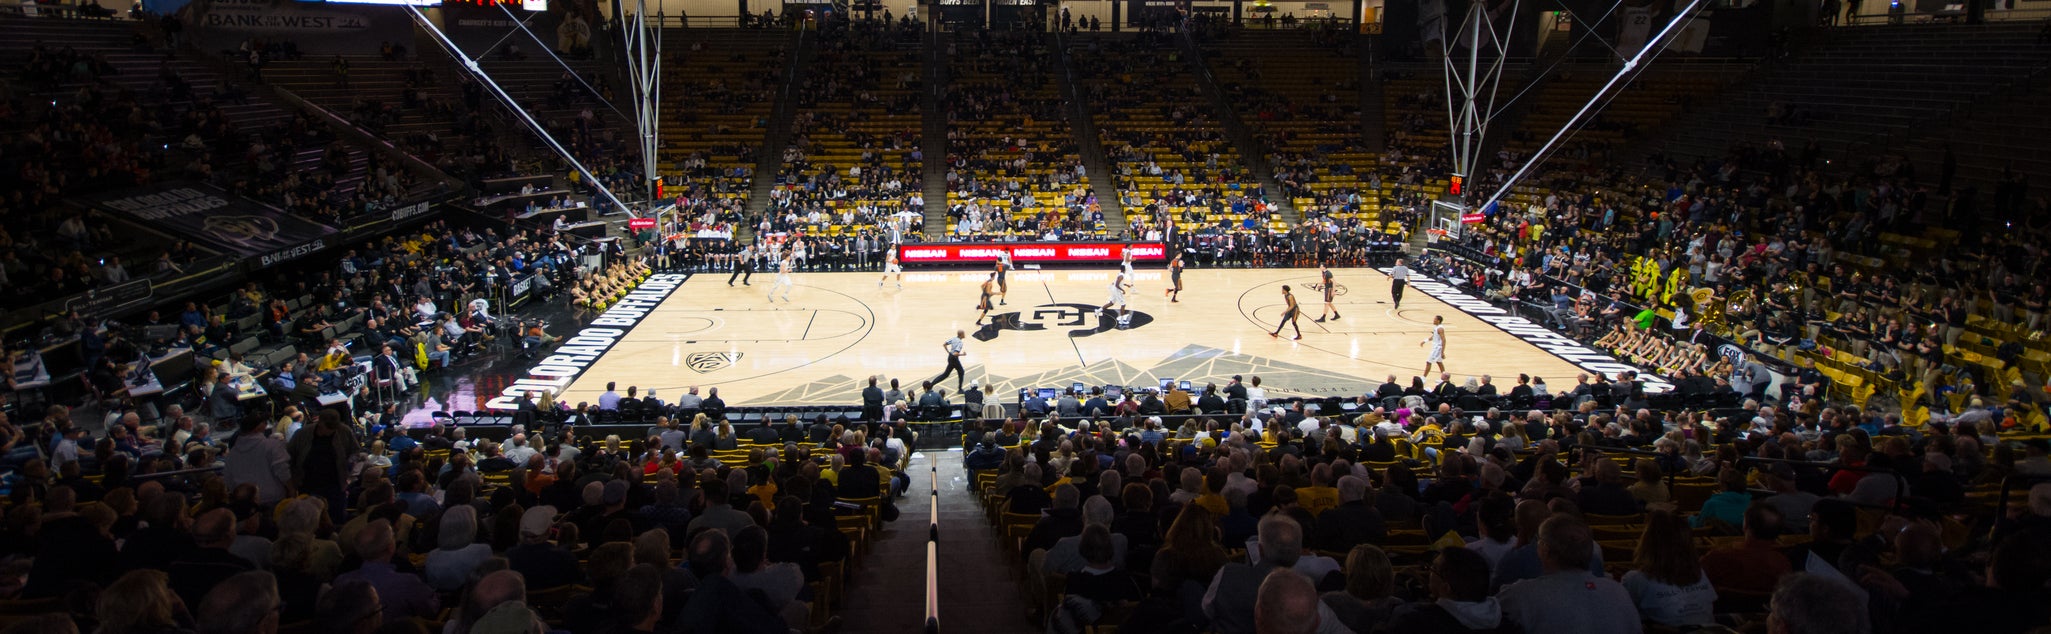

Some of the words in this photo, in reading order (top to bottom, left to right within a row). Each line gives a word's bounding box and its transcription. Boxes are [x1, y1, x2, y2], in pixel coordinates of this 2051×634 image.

[208, 13, 263, 27] BANK
[282, 16, 336, 28] WEST
[1634, 16, 1647, 25] 22
[905, 249, 947, 258] NISSAN
[1014, 248, 1056, 257] NISSAN
[1068, 248, 1109, 256] NISSAN
[590, 273, 687, 326] BUFFALOES
